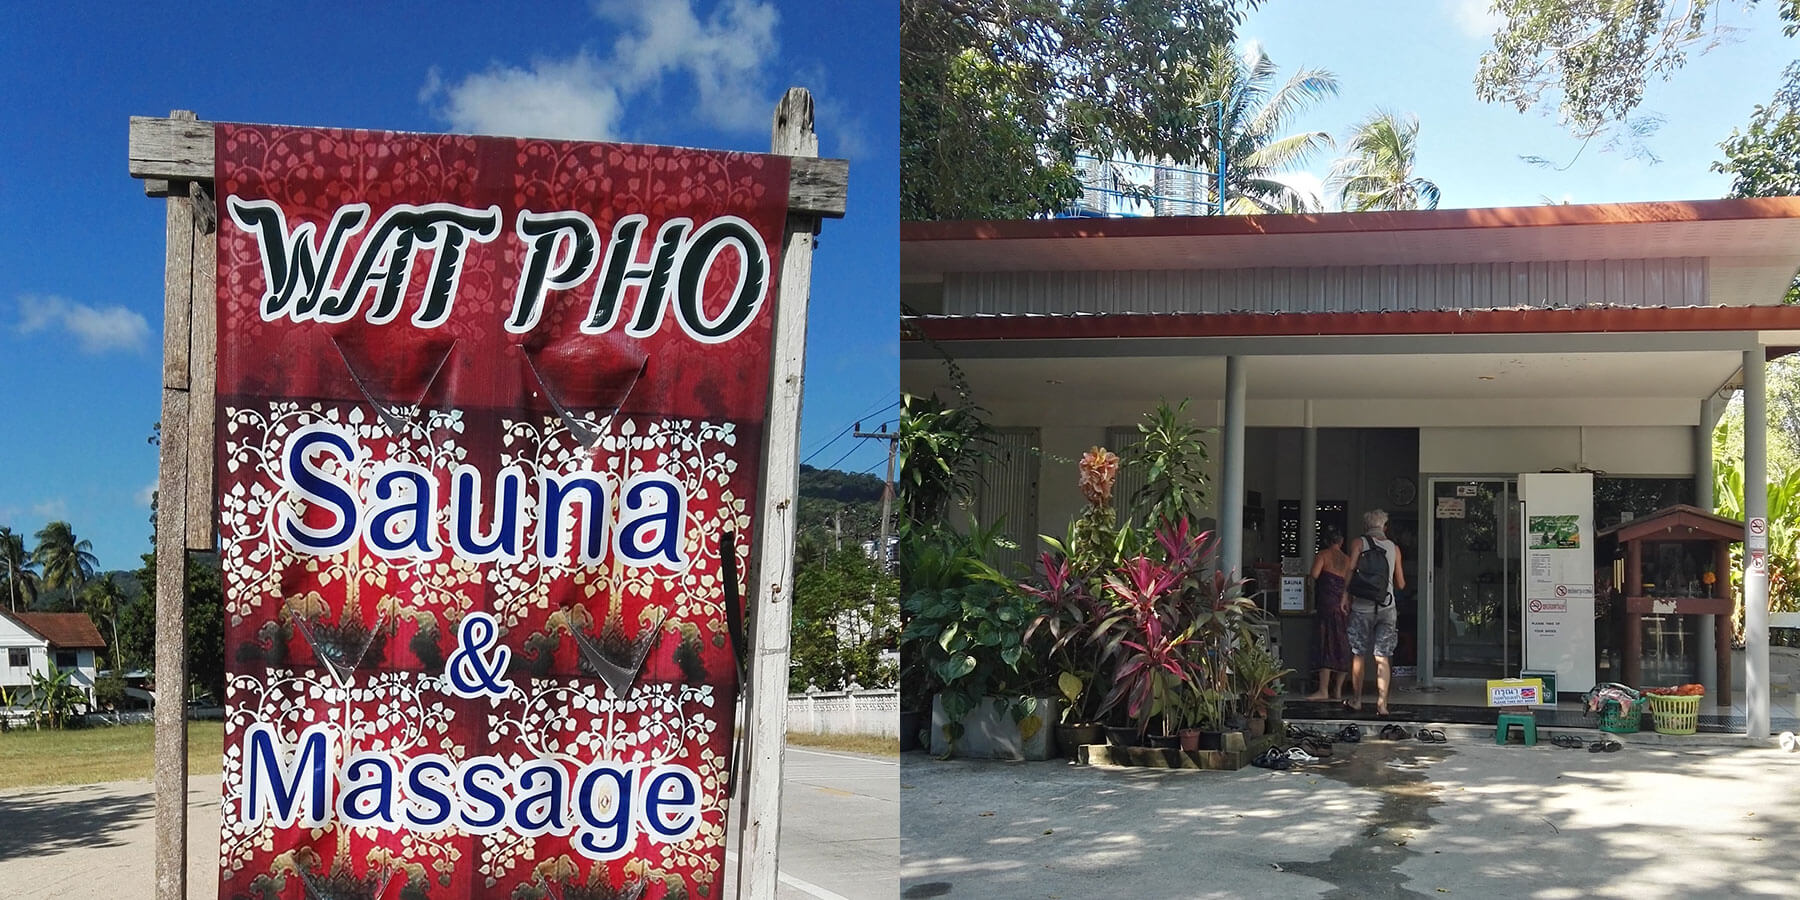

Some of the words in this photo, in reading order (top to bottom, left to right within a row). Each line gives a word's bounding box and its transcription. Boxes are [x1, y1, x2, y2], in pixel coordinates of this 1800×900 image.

[229, 196, 501, 327] WAT
[506, 211, 769, 342] PHO
[285, 429, 685, 565] Sauna
[447, 614, 510, 697] &
[245, 727, 700, 857] Massage
